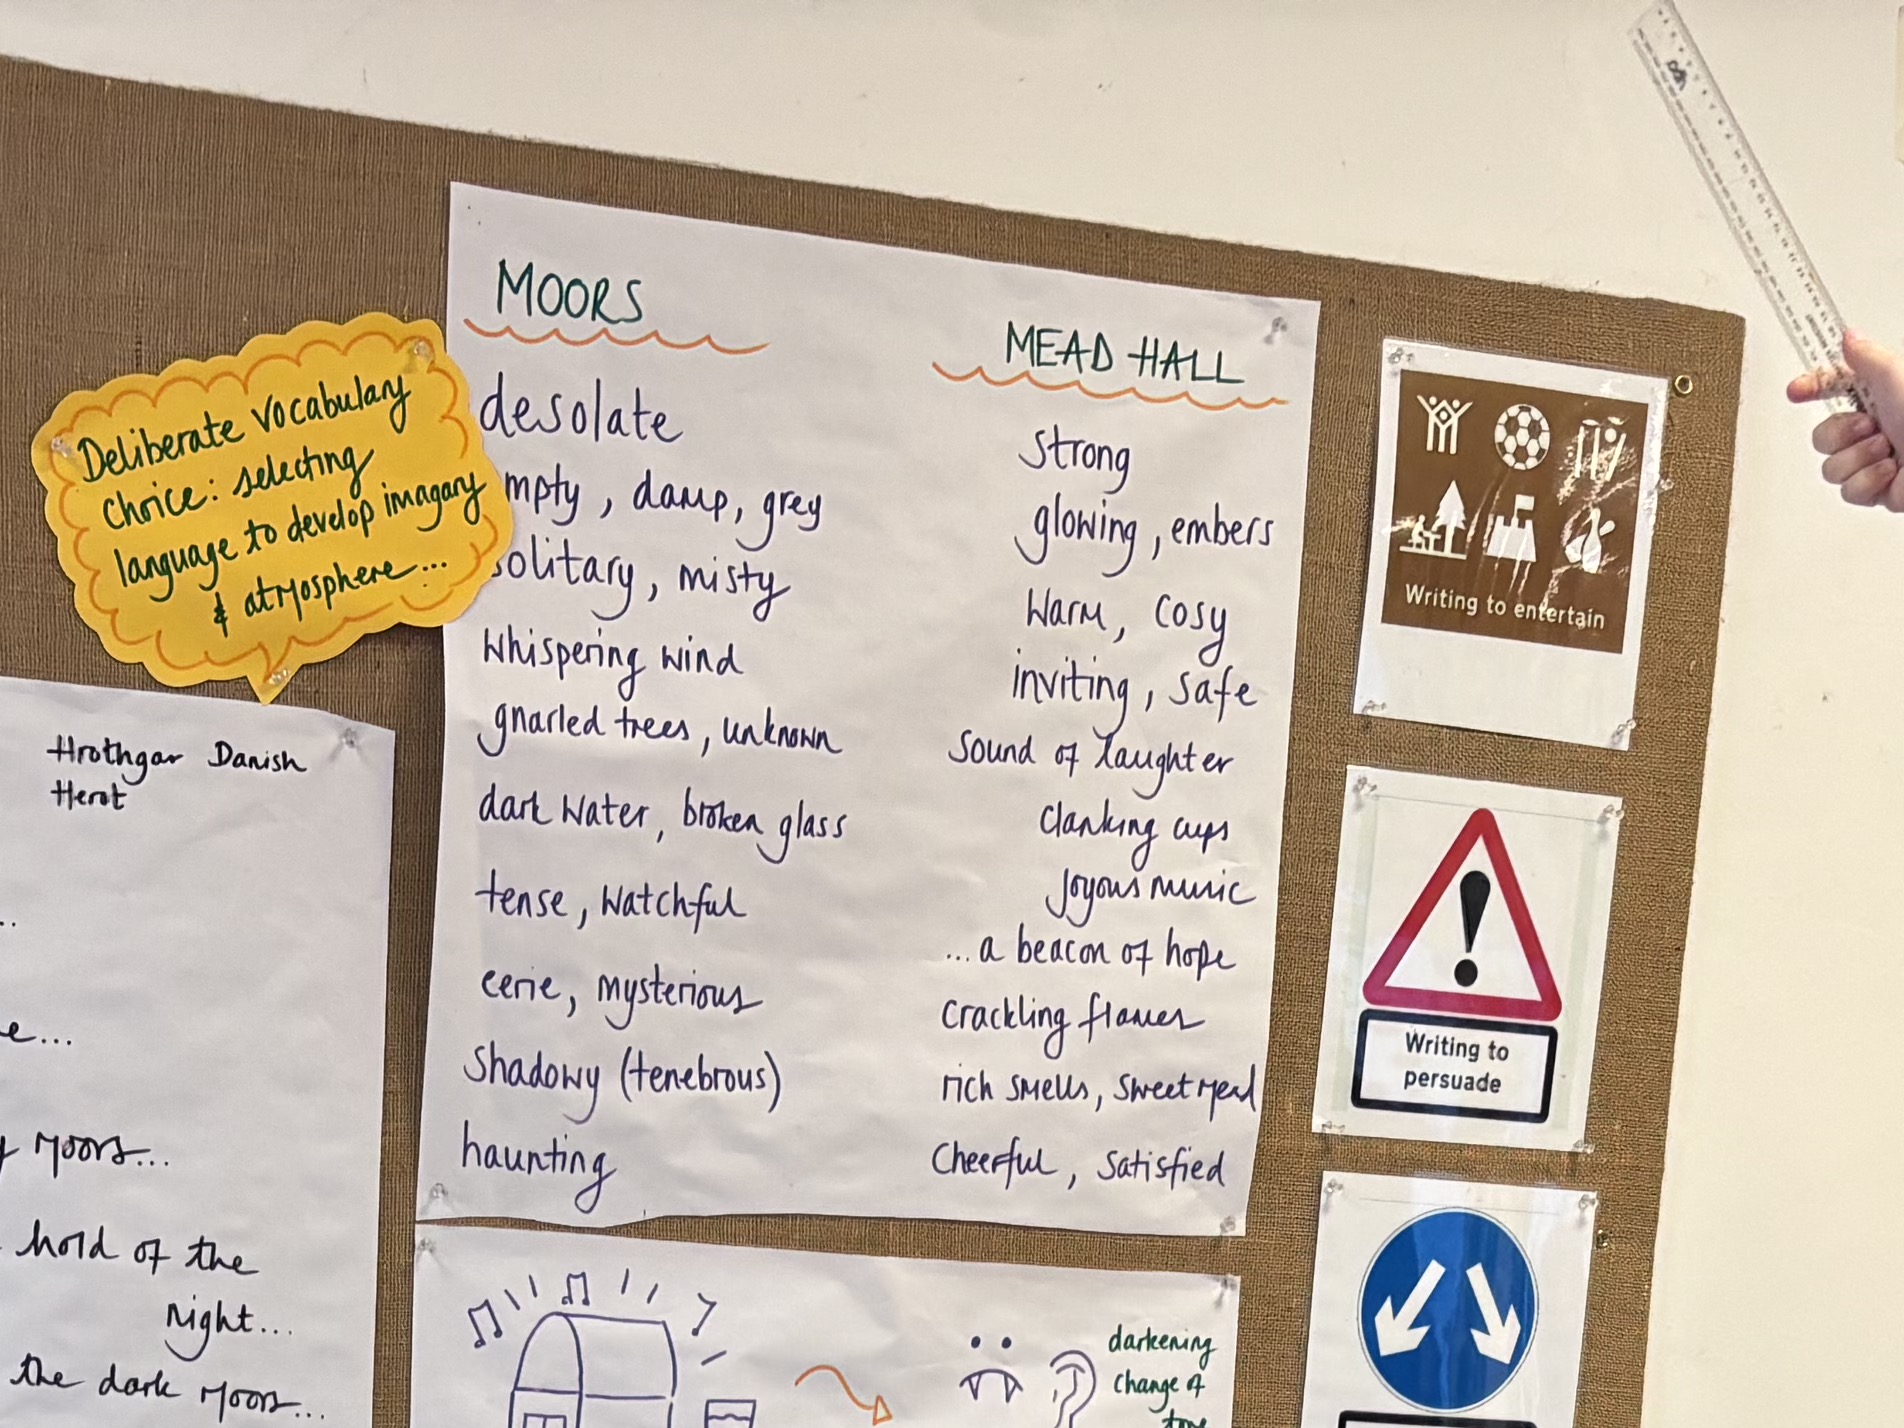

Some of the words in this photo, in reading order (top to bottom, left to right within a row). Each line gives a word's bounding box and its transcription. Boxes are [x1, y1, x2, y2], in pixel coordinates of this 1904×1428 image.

[495, 257, 644, 326] MOORS
[1004, 319, 1115, 375] MEAD
[1126, 334, 1246, 386] HALL
[478, 369, 684, 445] desolate
[76, 410, 246, 484] Deliberate
[231, 444, 376, 500] selecting
[112, 537, 239, 604] language
[286, 497, 376, 543] develop
[733, 489, 823, 553] grey
[1012, 490, 1139, 580] glowing
[1170, 501, 1275, 548] embers
[1404, 582, 1479, 617] Writing
[1485, 594, 1508, 617] to
[1512, 597, 1606, 630] entertain
[45, 733, 185, 787] Hrothgar
[206, 739, 309, 774] Danish
[475, 701, 607, 759] gnarled
[477, 781, 553, 826] dark
[682, 785, 765, 836] broken
[755, 798, 849, 866] glass
[473, 867, 589, 931] tense,
[1016, 921, 1111, 966] beacon
[1164, 925, 1237, 983] hope
[480, 968, 578, 1019] eerie,
[1404, 1030, 1482, 1064] Writing
[1486, 1039, 1511, 1063] to
[619, 1044, 783, 1114] (tenebrous)
[941, 1068, 995, 1104] rich
[1402, 1069, 1503, 1095] persuade
[460, 1118, 618, 1216] haunting
[14, 1217, 120, 1261] hold
[97, 1361, 182, 1400] dark
